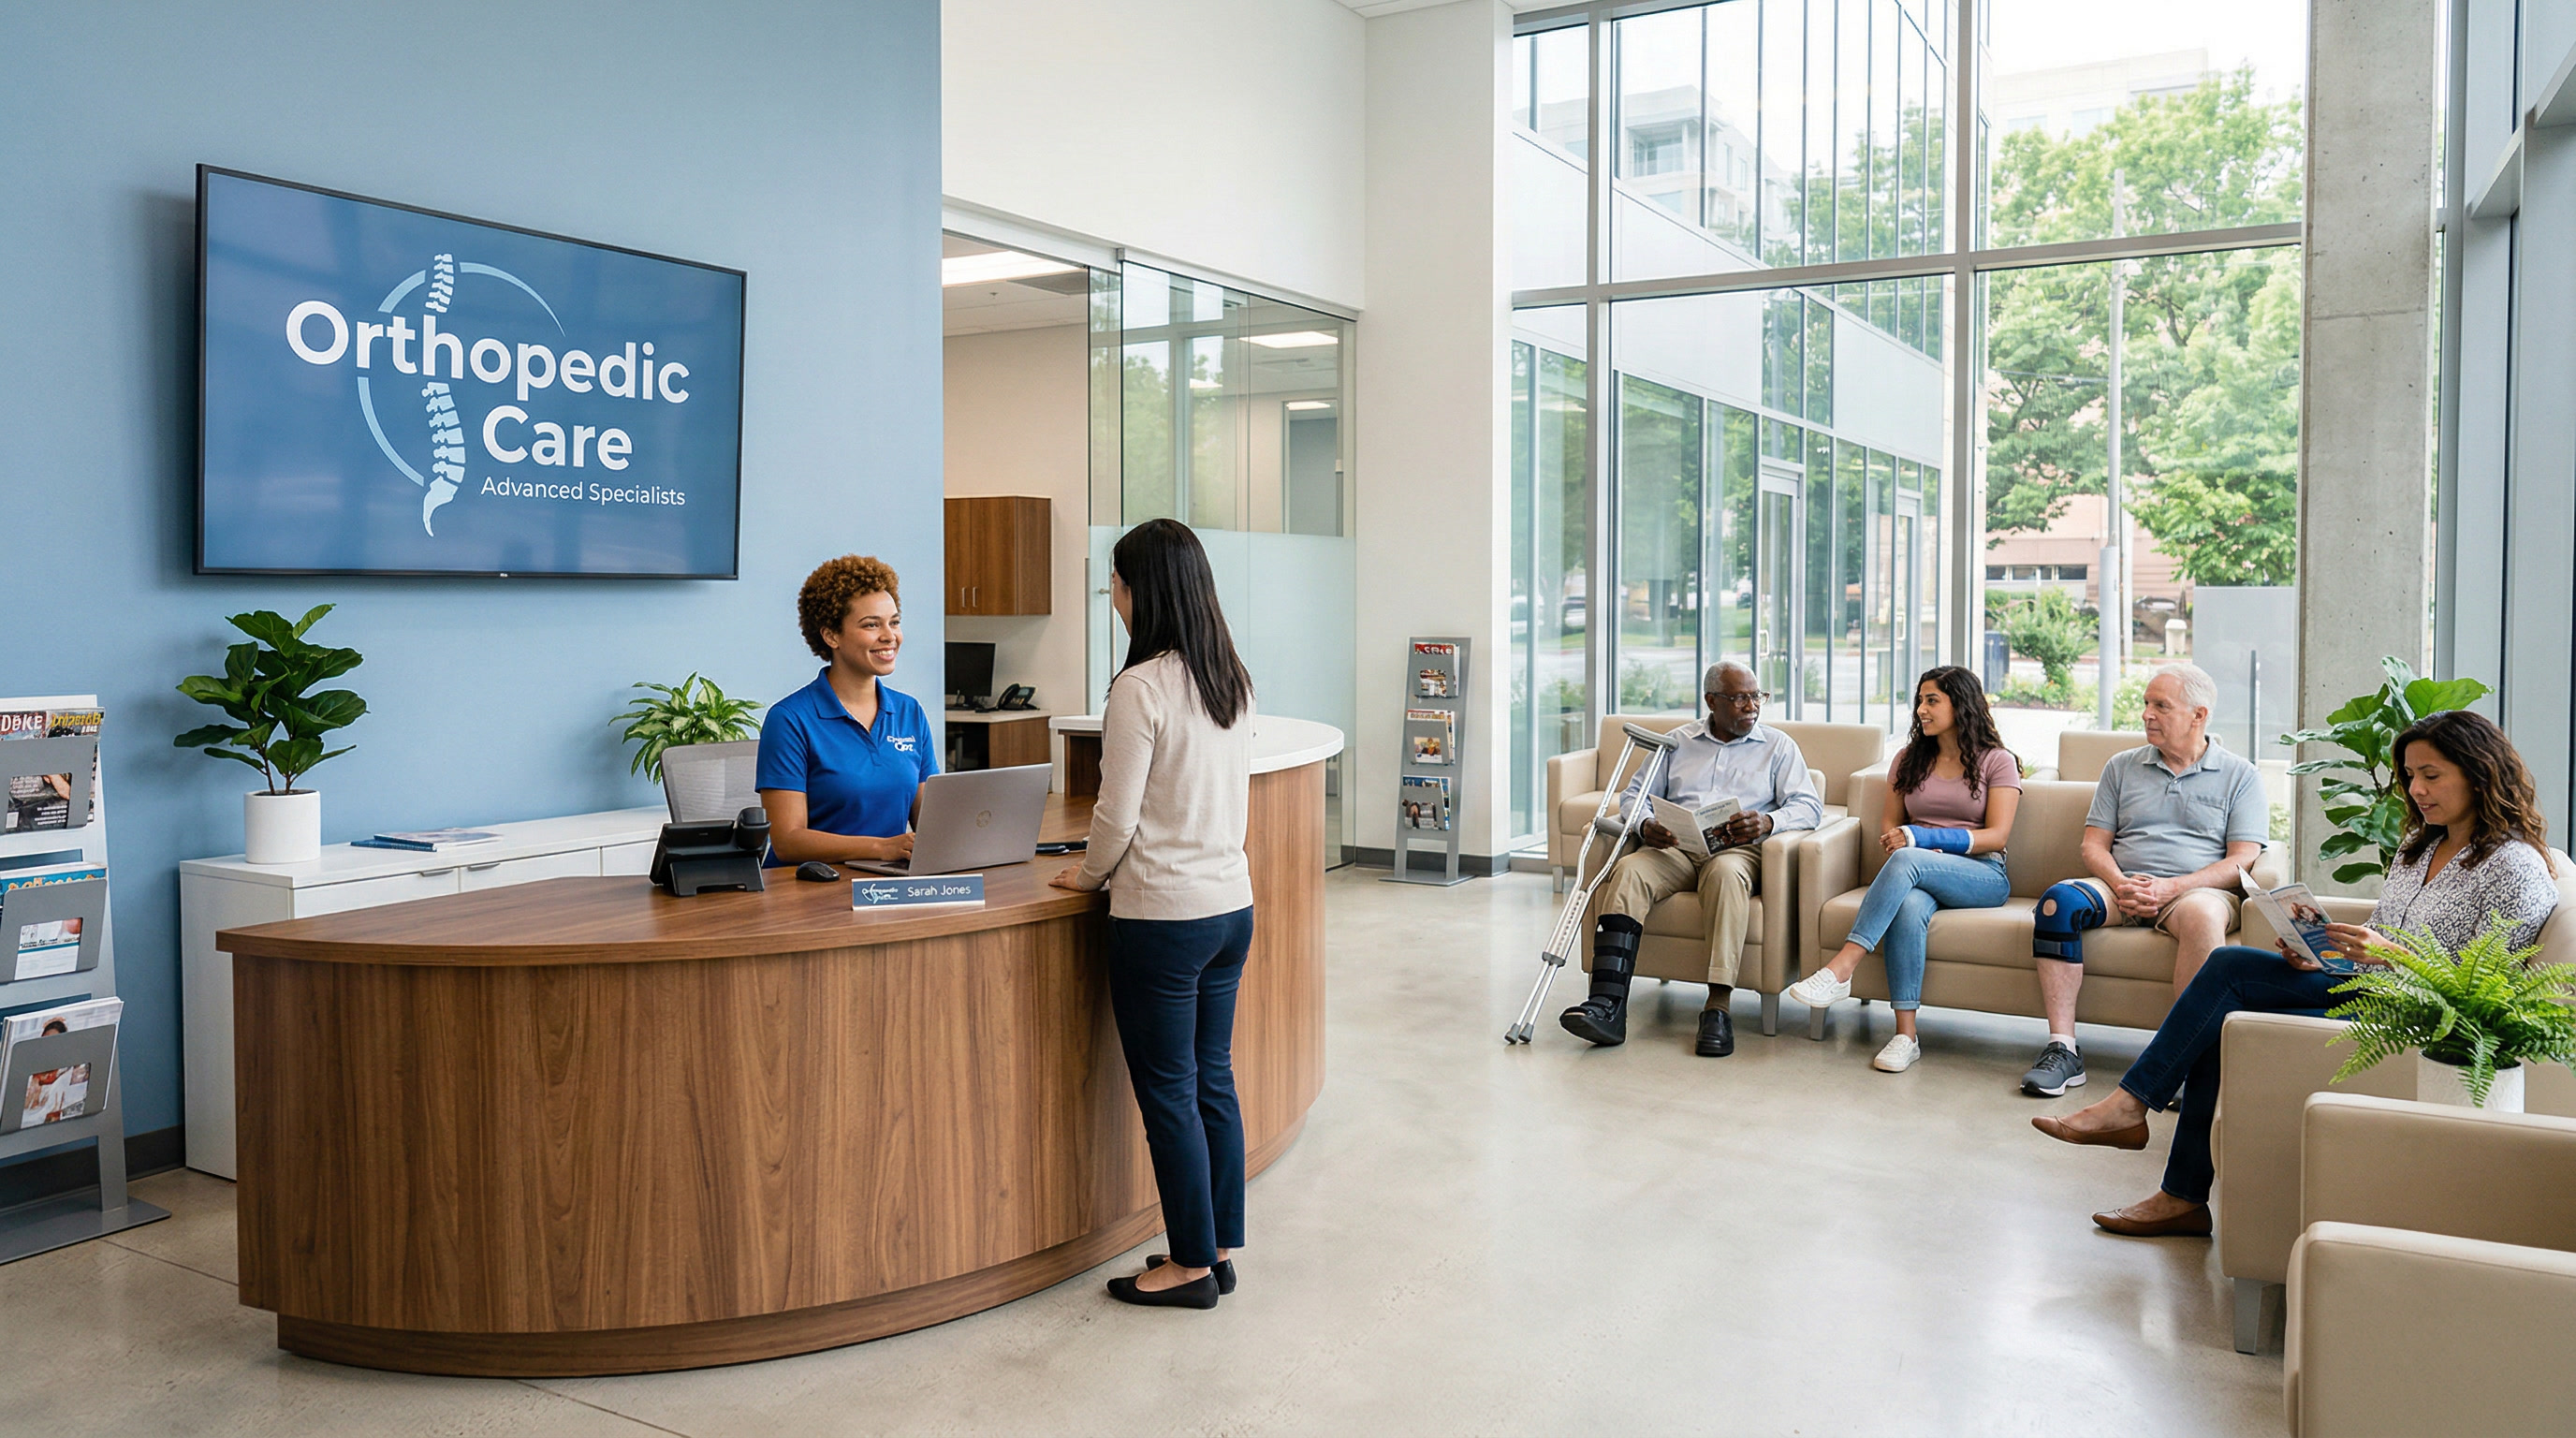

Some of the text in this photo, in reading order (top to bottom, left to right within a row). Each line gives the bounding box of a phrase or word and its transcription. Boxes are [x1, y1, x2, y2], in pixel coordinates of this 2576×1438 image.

[285, 301, 691, 404] Orthopedic
[482, 405, 633, 470] Care
[480, 476, 687, 506] Advanced Specialists
[907, 885, 938, 898] Sarah
[940, 884, 972, 897] Jones
